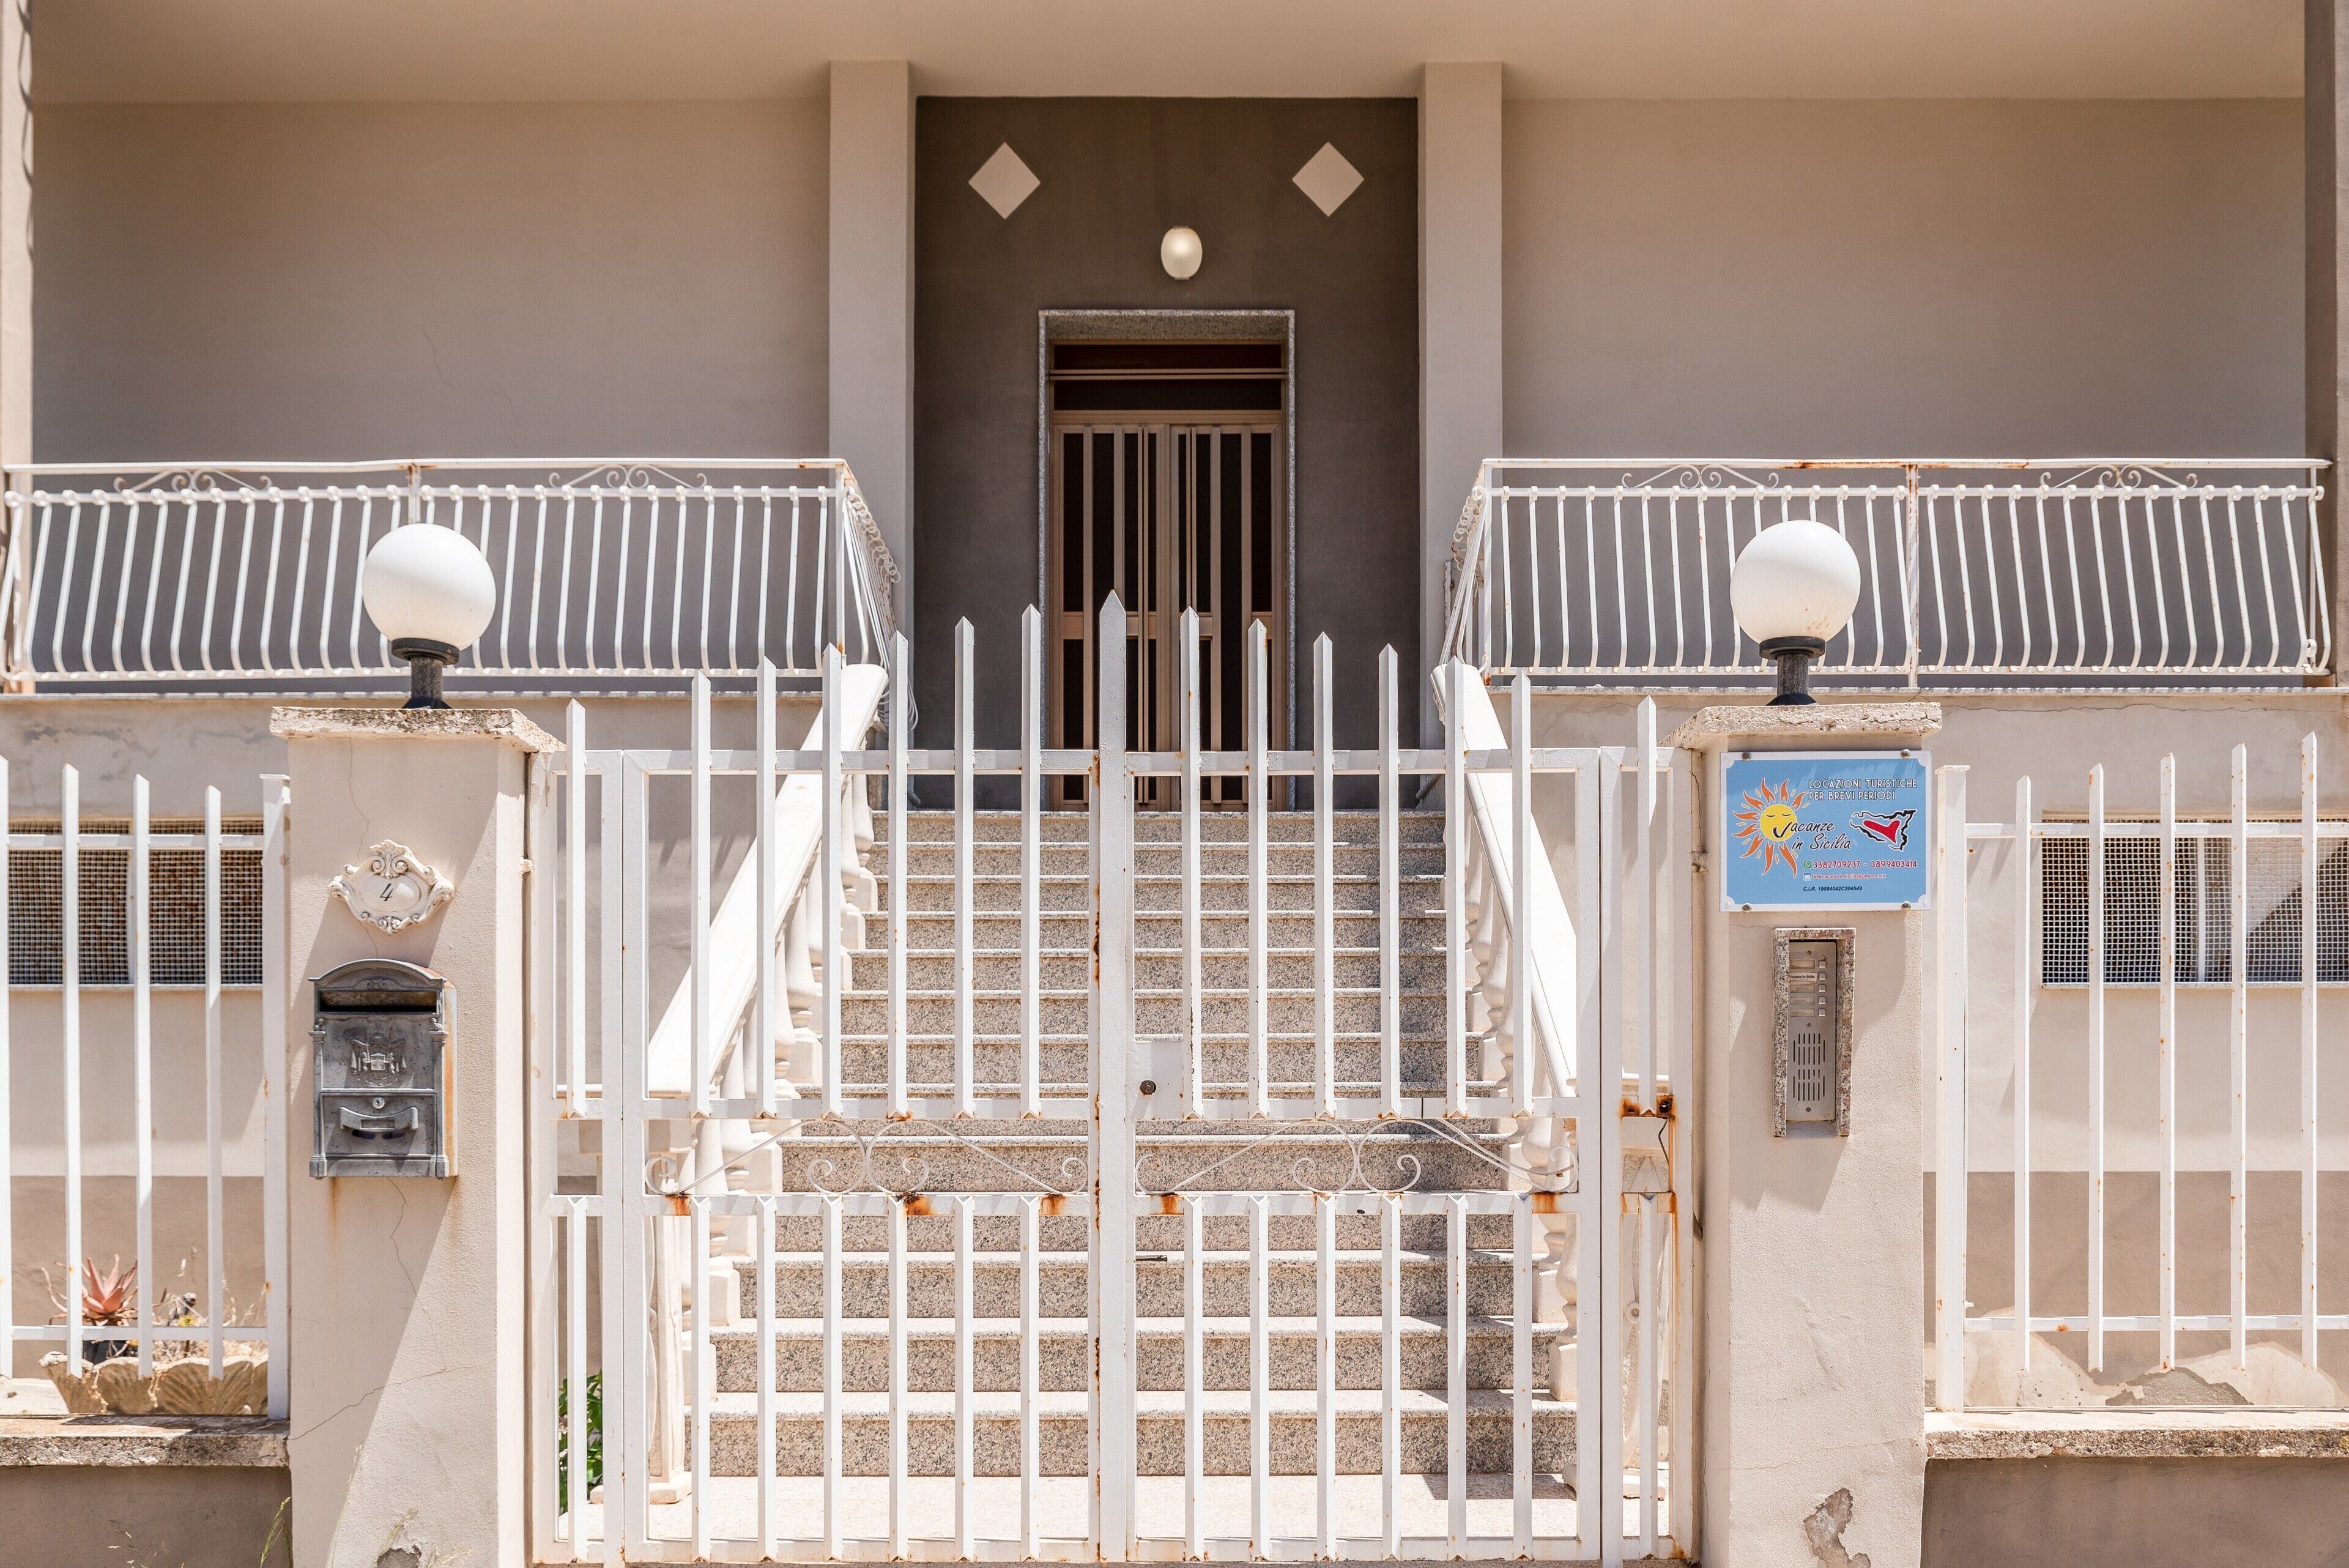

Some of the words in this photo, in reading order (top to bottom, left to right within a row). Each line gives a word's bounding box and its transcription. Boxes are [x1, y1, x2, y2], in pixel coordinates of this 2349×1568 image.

[1808, 779, 1861, 789] LOCAZIONI
[1866, 778, 1918, 788] TURISTICHE
[1808, 791, 1824, 800] PER
[1828, 791, 1855, 800] BREVI
[1858, 790, 1896, 800] PERIODI
[1773, 821, 1835, 838] Vacanze
[1792, 837, 1803, 850] in
[1809, 833, 1851, 850] Sicilia
[380, 883, 393, 902] 4
